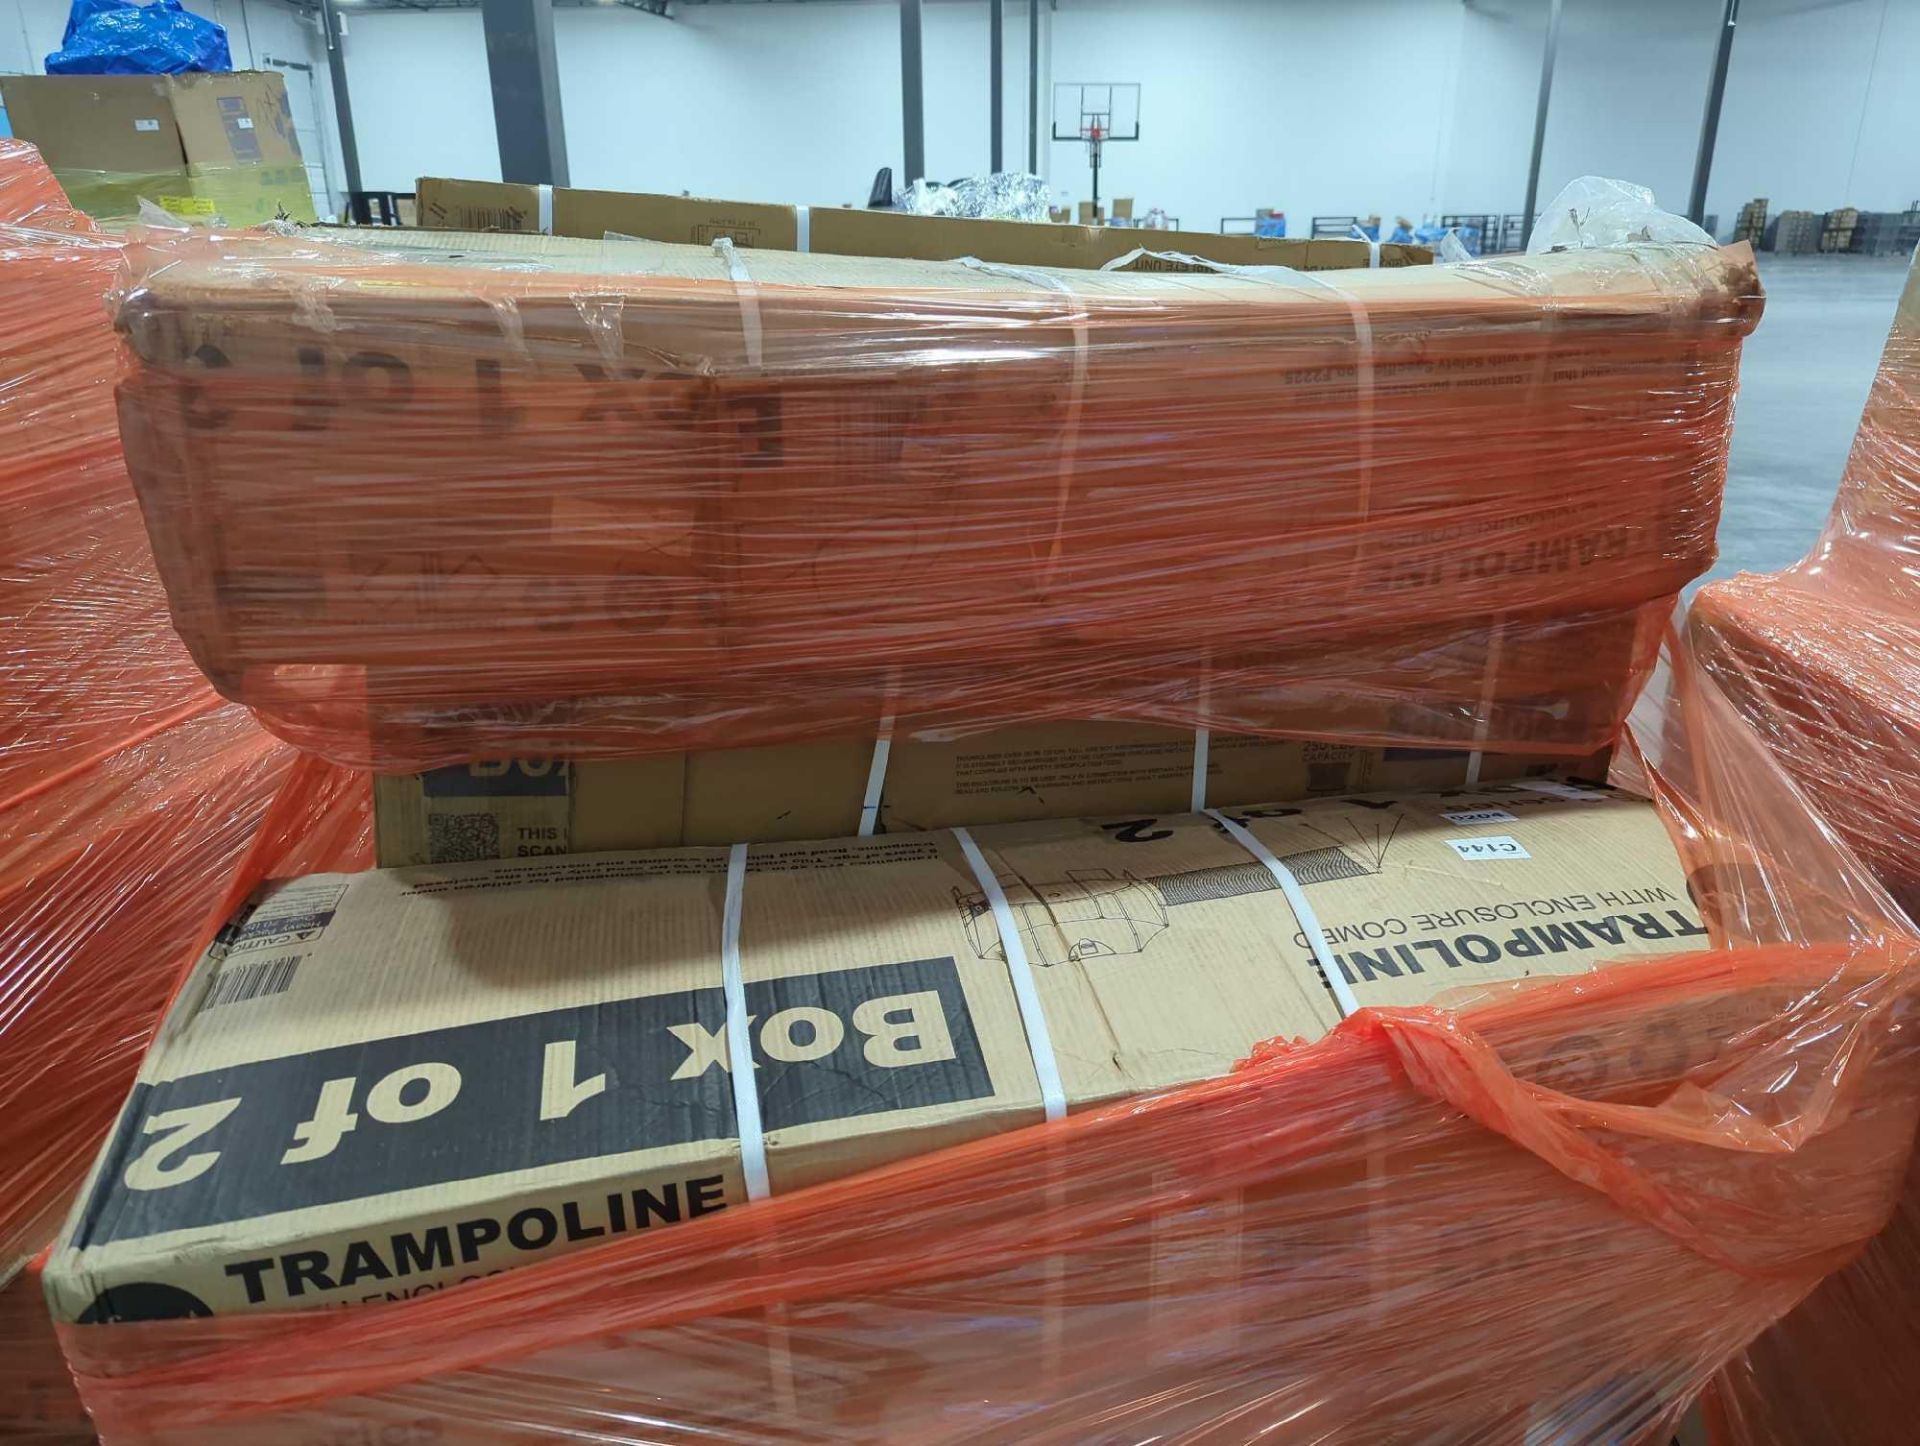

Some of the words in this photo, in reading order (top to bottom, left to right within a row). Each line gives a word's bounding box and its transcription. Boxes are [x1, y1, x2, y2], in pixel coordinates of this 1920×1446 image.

[516, 827, 558, 841] THIS
[1100, 818, 1174, 843] 2
[1457, 843, 1518, 853] C144
[1411, 893, 1597, 931] ENCLOSURE
[1599, 887, 1679, 908] WITH
[666, 990, 958, 1082] Box
[539, 1040, 607, 1121] 1
[280, 1061, 463, 1166] of
[124, 1097, 243, 1192] 2
[225, 1173, 729, 1304] TRAMPOLINE
